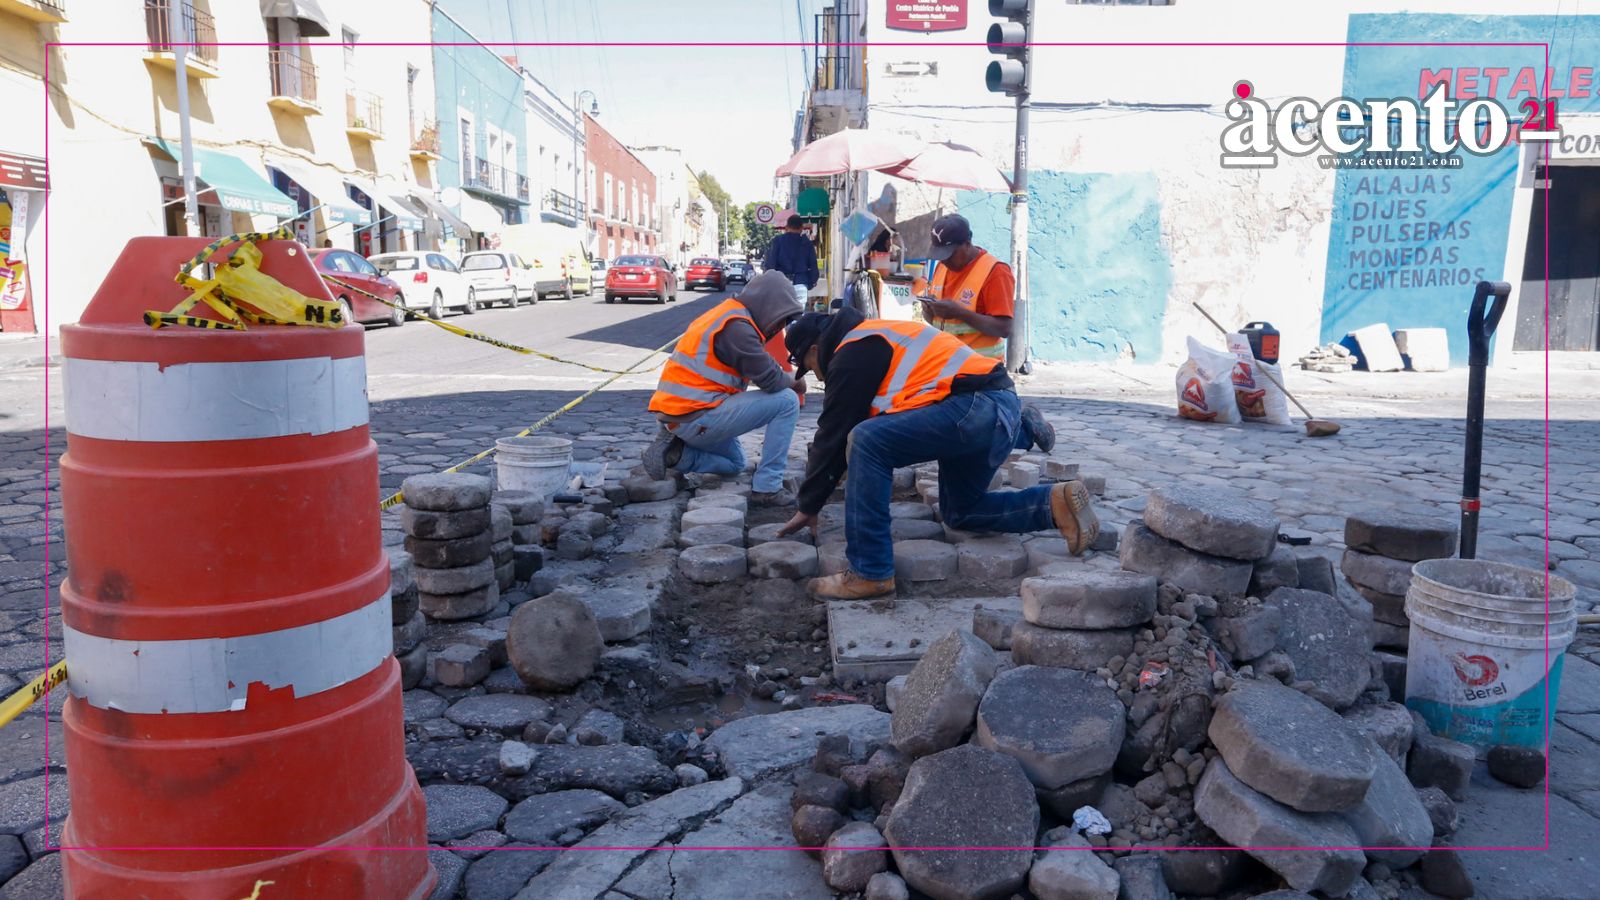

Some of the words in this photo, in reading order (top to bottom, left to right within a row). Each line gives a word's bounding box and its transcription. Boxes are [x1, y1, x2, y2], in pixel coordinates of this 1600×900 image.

[896, 4, 912, 12] Centro
[1352, 199, 1427, 221] DIJES
[1351, 220, 1471, 245] PULSERAS
[1349, 246, 1460, 269] MONEDAS
[1348, 267, 1486, 290] CENTENARIOS
[1463, 682, 1507, 701] Berel
